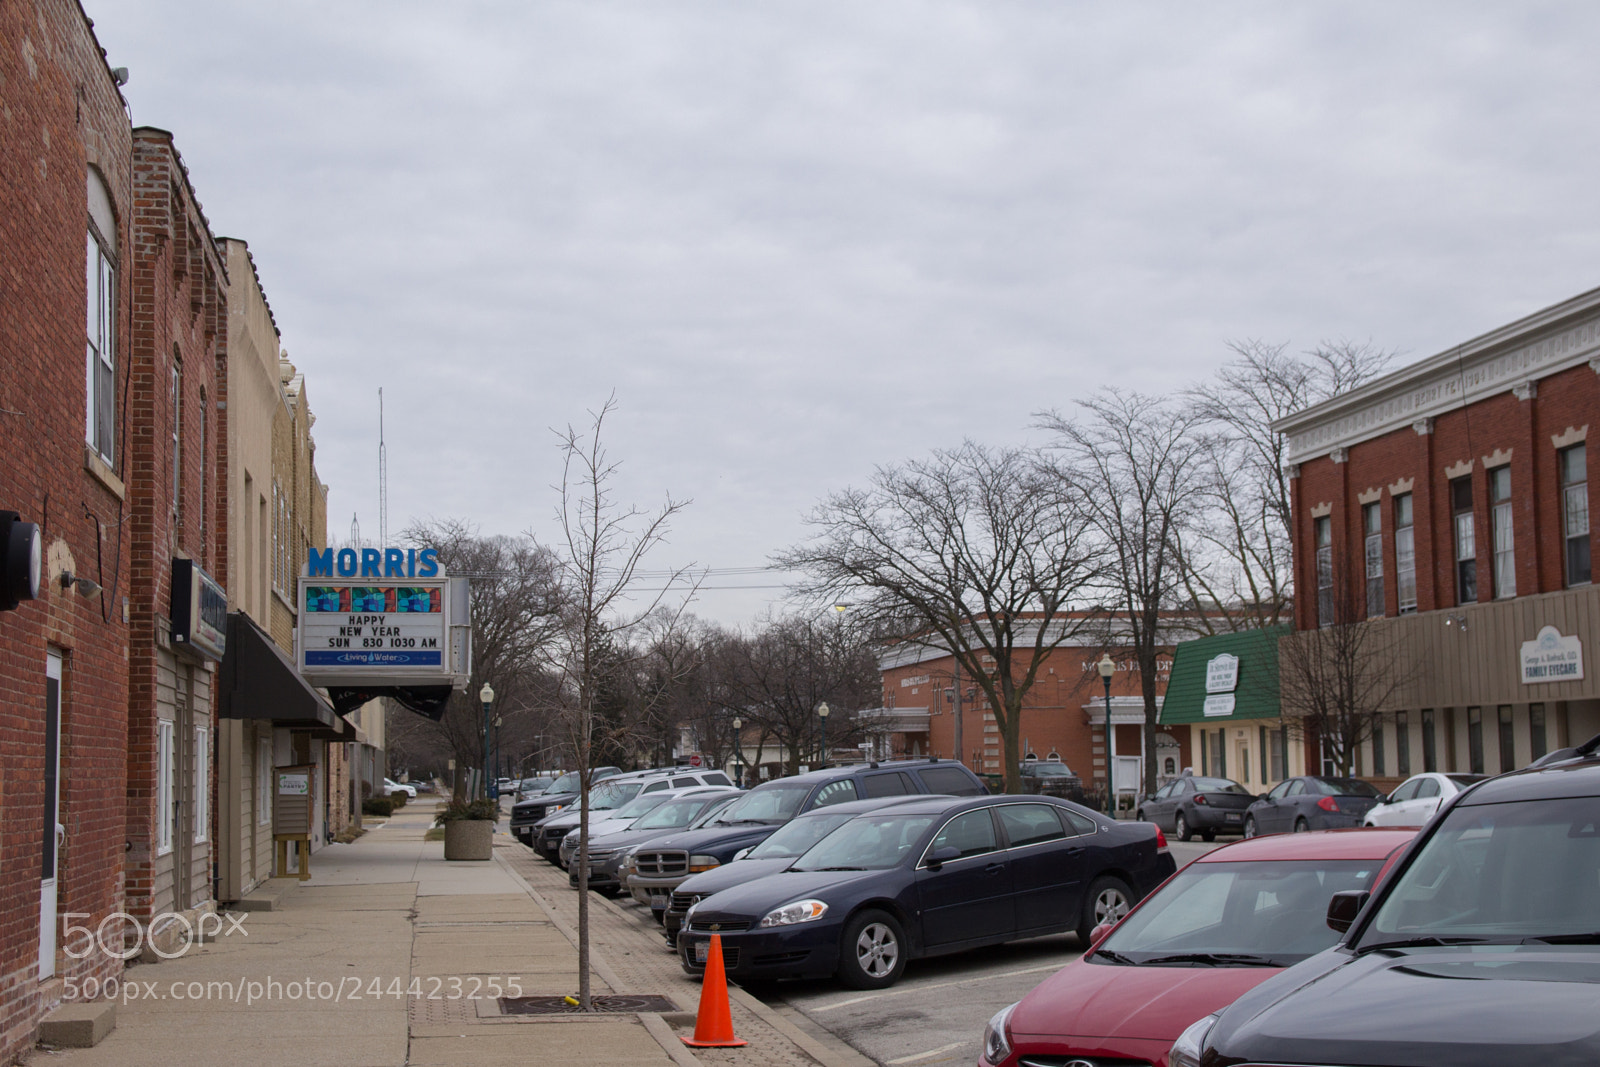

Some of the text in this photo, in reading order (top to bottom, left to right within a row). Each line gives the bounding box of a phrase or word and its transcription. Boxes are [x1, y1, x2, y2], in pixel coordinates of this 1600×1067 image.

[308, 547, 439, 577] MORRIS
[349, 615, 385, 625] HAPPY
[339, 626, 400, 636] NEW YEAR
[328, 638, 437, 648] SUN 830 1030 AM
[345, 653, 398, 662] Living Water
[1525, 663, 1577, 678] FAMILY EYECARE
